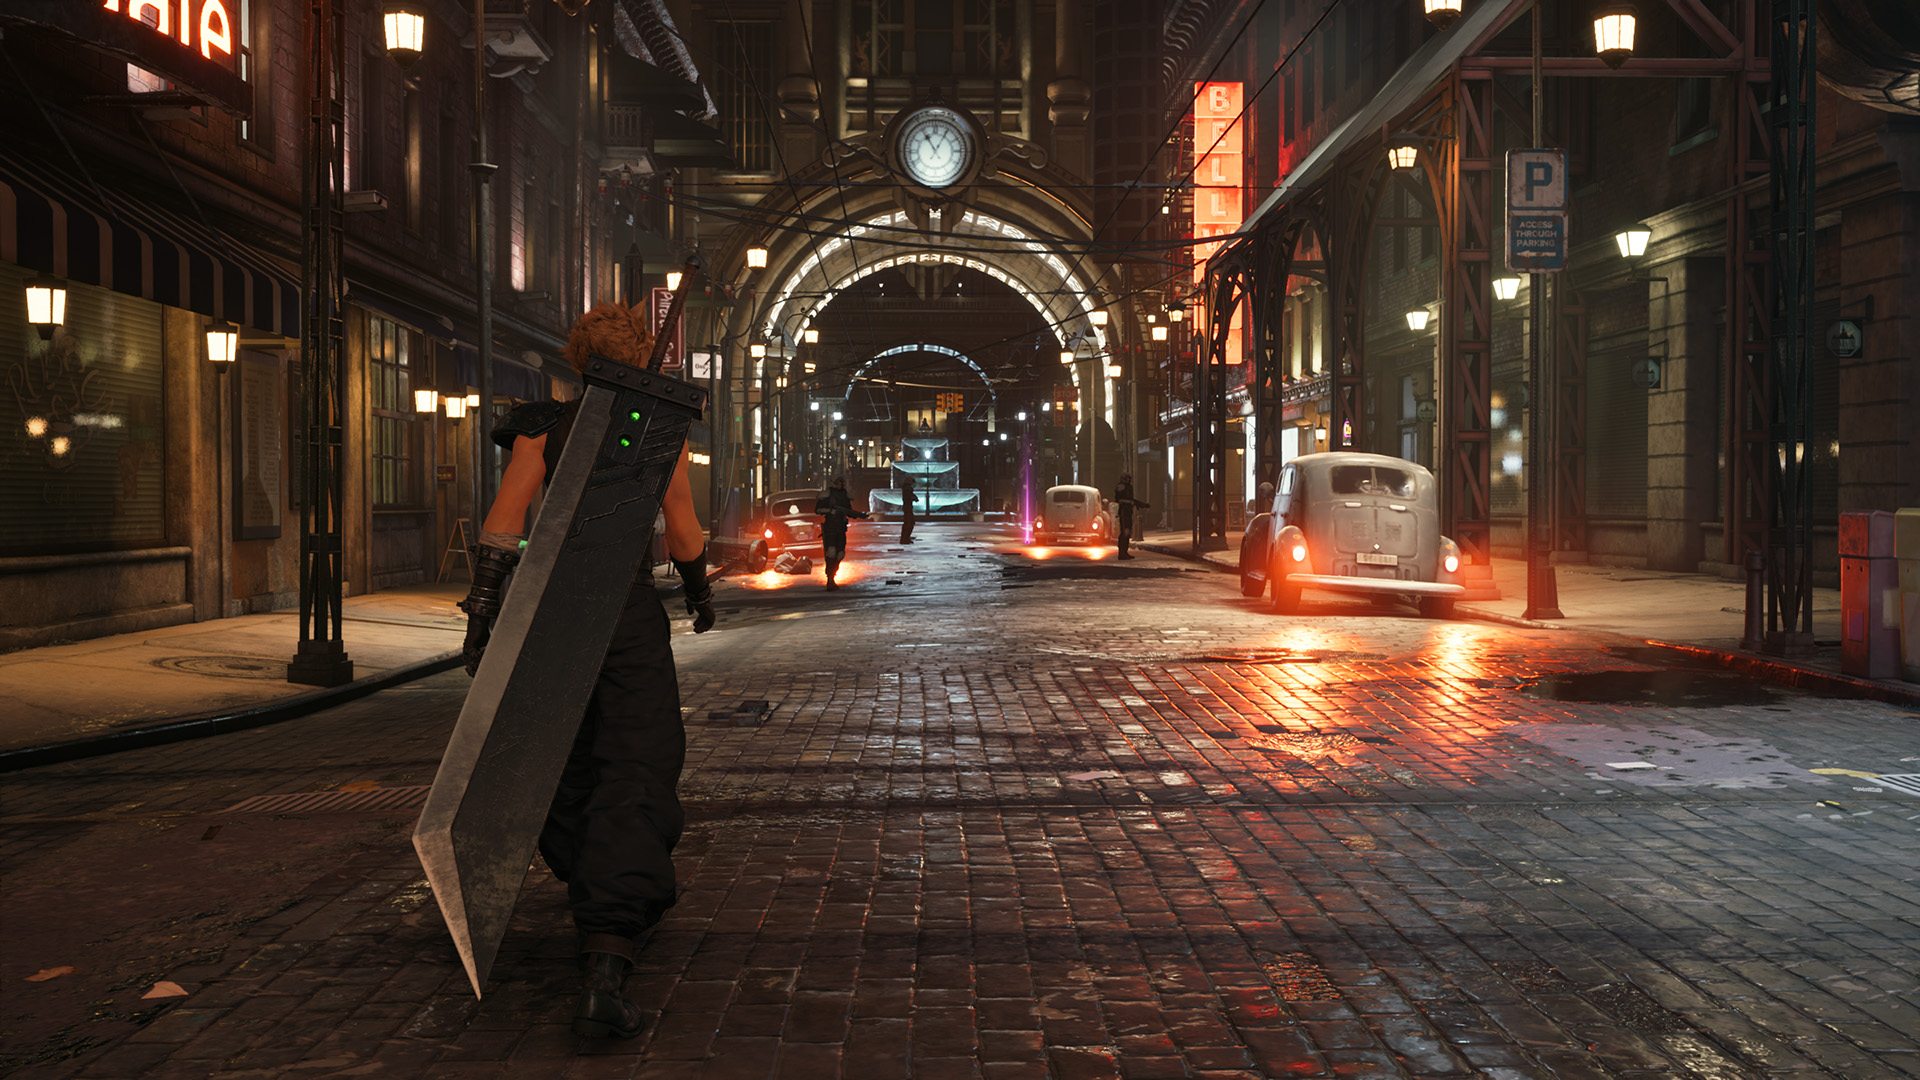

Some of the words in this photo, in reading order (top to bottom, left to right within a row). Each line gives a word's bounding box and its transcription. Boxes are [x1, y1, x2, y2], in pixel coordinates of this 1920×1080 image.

[1525, 162, 1552, 201] P
[1519, 221, 1553, 229] ACCESS
[1515, 229, 1557, 238] THROUGH
[1516, 239, 1555, 248] PARKING
